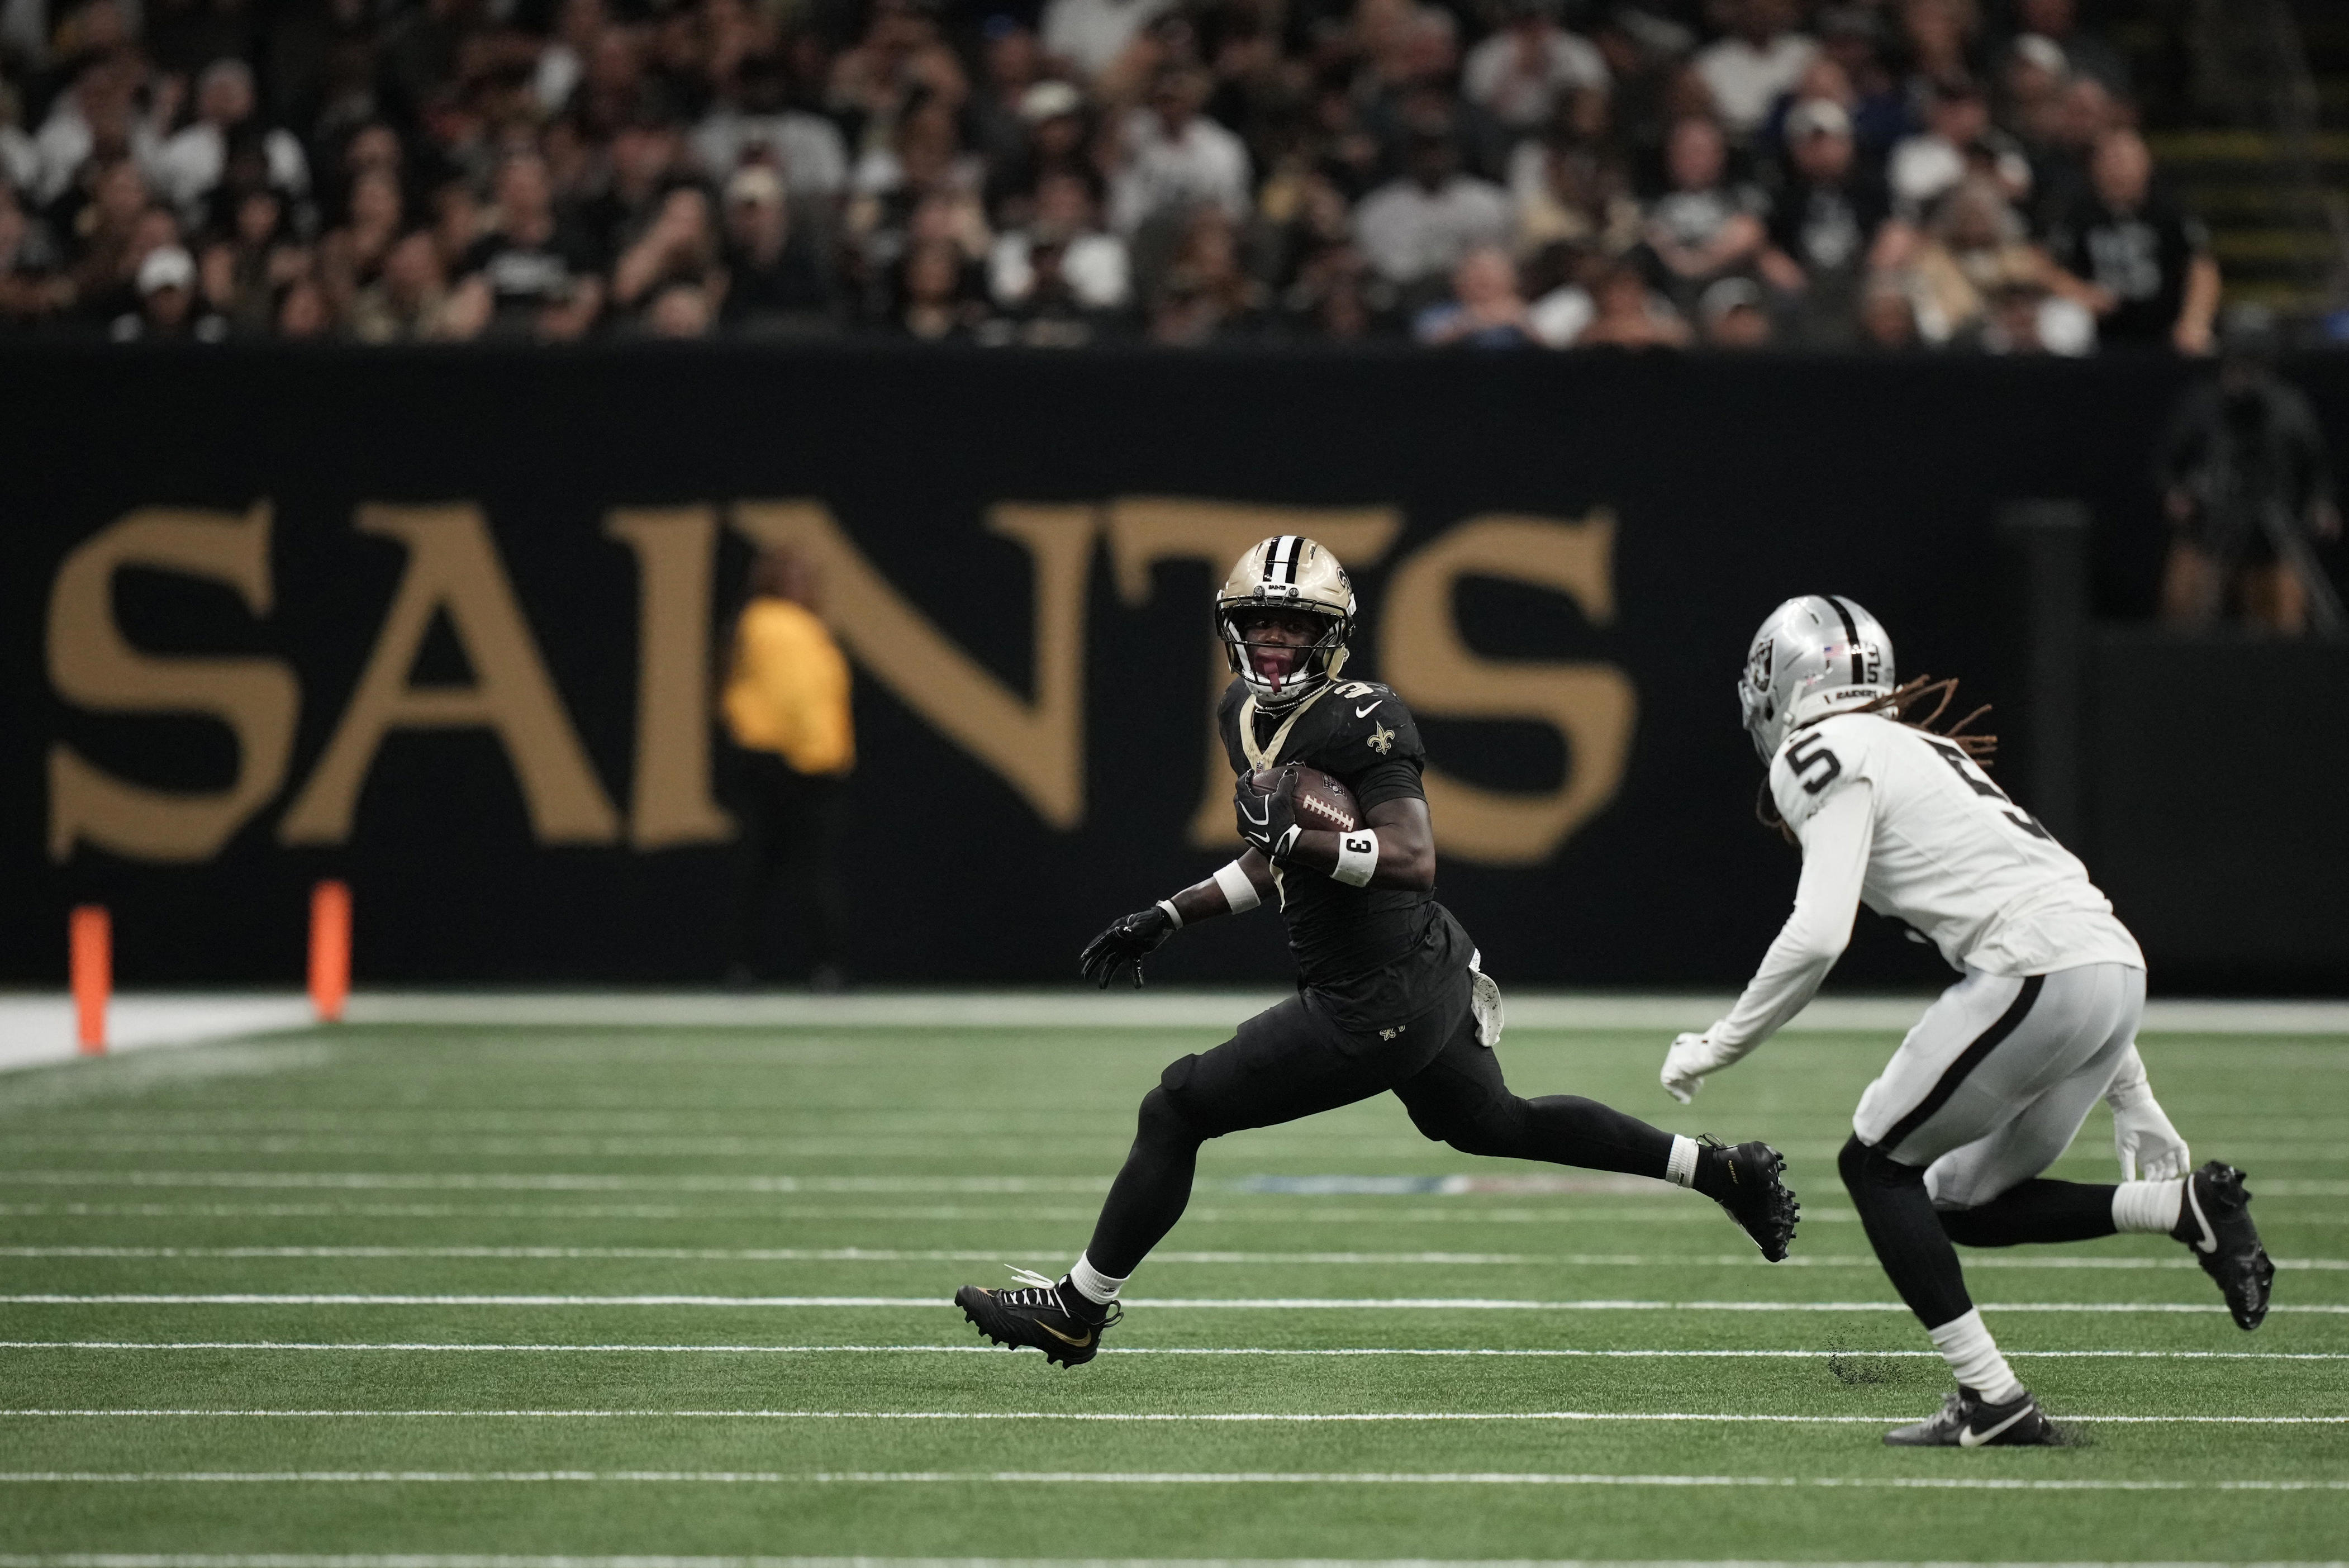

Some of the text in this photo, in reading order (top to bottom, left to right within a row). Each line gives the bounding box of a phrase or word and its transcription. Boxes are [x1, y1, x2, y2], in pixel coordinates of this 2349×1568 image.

[46, 495, 1635, 864] SAINTS
[1785, 733, 1841, 795] 5
[1346, 838, 1371, 853] 3
